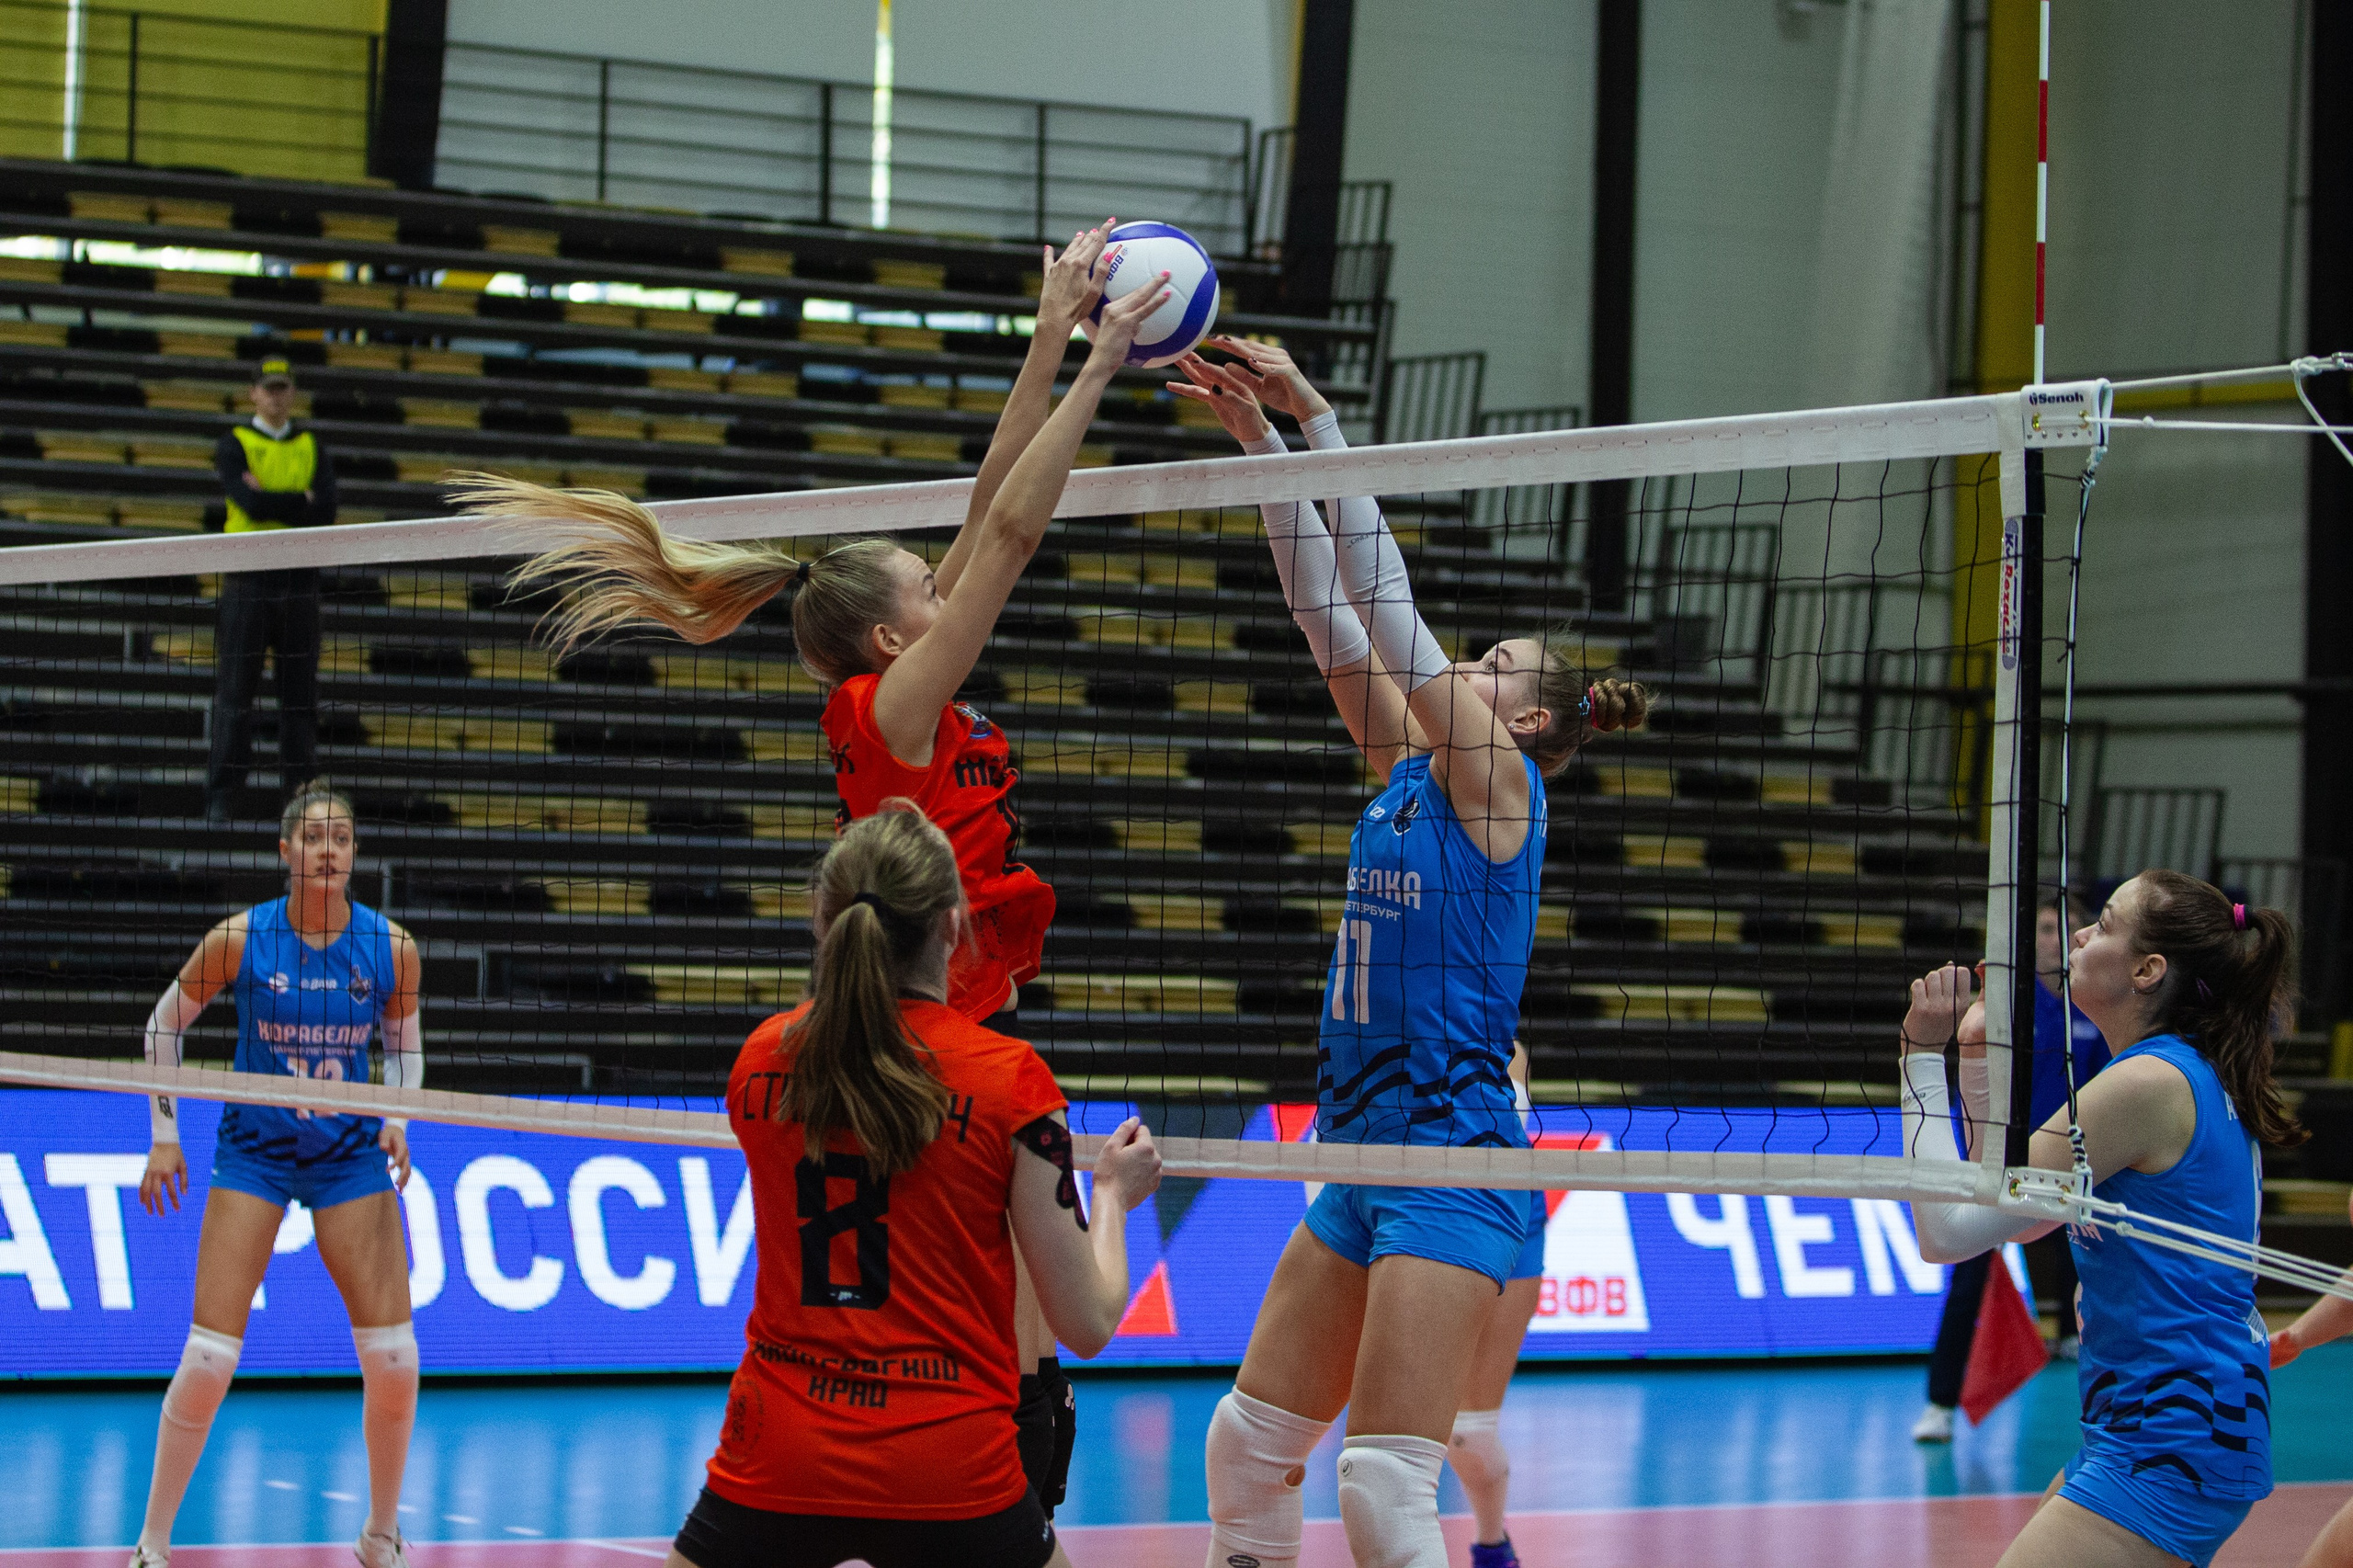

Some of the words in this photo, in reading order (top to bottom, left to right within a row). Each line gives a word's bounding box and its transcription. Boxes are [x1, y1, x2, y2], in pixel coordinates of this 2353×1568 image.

[2039, 392, 2084, 404] Senoh
[795, 1151, 890, 1311] 8
[1536, 1276, 1627, 1315] ВФВ
